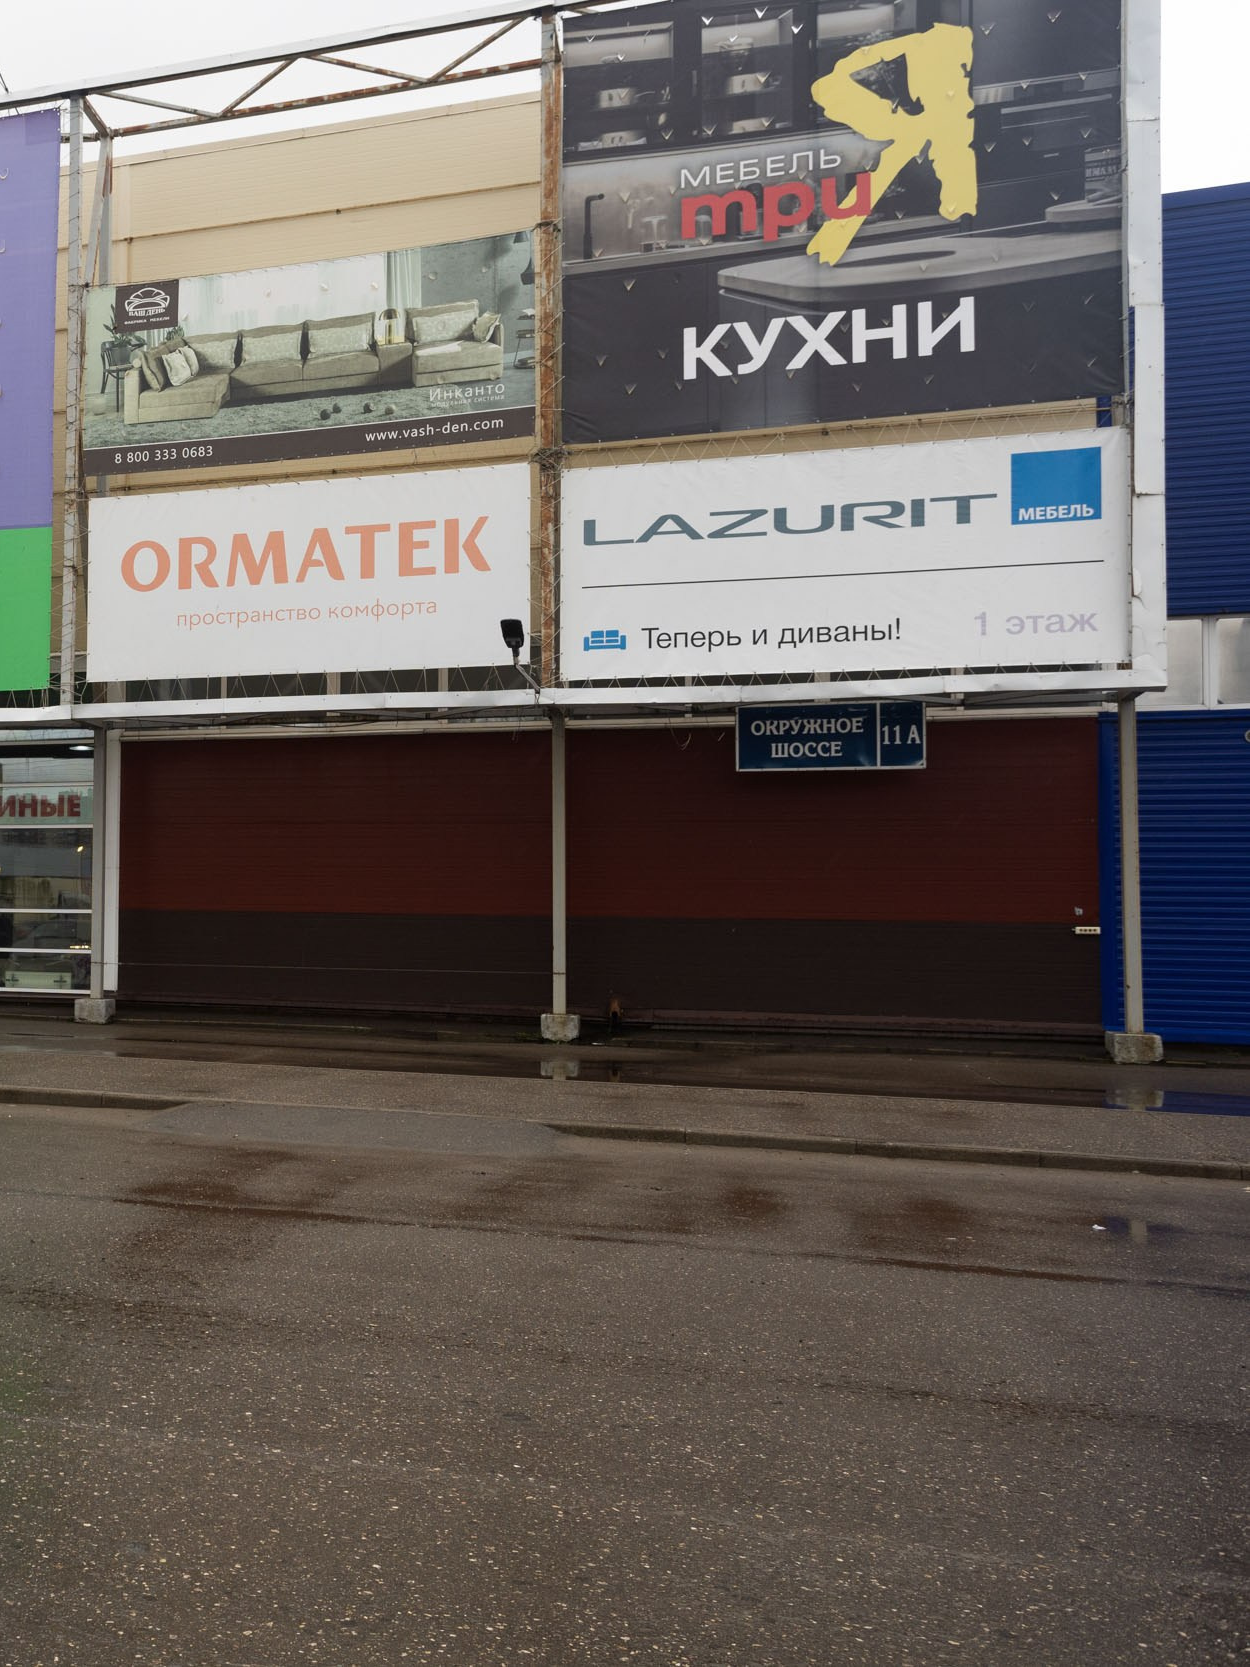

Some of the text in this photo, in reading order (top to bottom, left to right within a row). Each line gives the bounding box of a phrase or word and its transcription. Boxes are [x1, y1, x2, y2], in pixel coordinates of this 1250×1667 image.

[806, 22, 977, 266] Я
[680, 148, 842, 189] МЕБЕЛЬ
[682, 296, 976, 381] КУХНИ
[430, 383, 505, 401] Инканто
[365, 418, 504, 442] www.vash-den.com
[114, 445, 213, 464] 8 800 333 0683
[583, 493, 997, 546] LAZURIT
[1018, 503, 1095, 522] МЕБЕЛЬ
[121, 516, 492, 593] ORMATEK
[177, 597, 437, 630] пространство комфорта
[974, 612, 1098, 636] 1 этаж
[641, 618, 902, 654] Теперь и диваны!
[882, 724, 922, 745] 11 А
[770, 741, 843, 759] ШОССЕ
